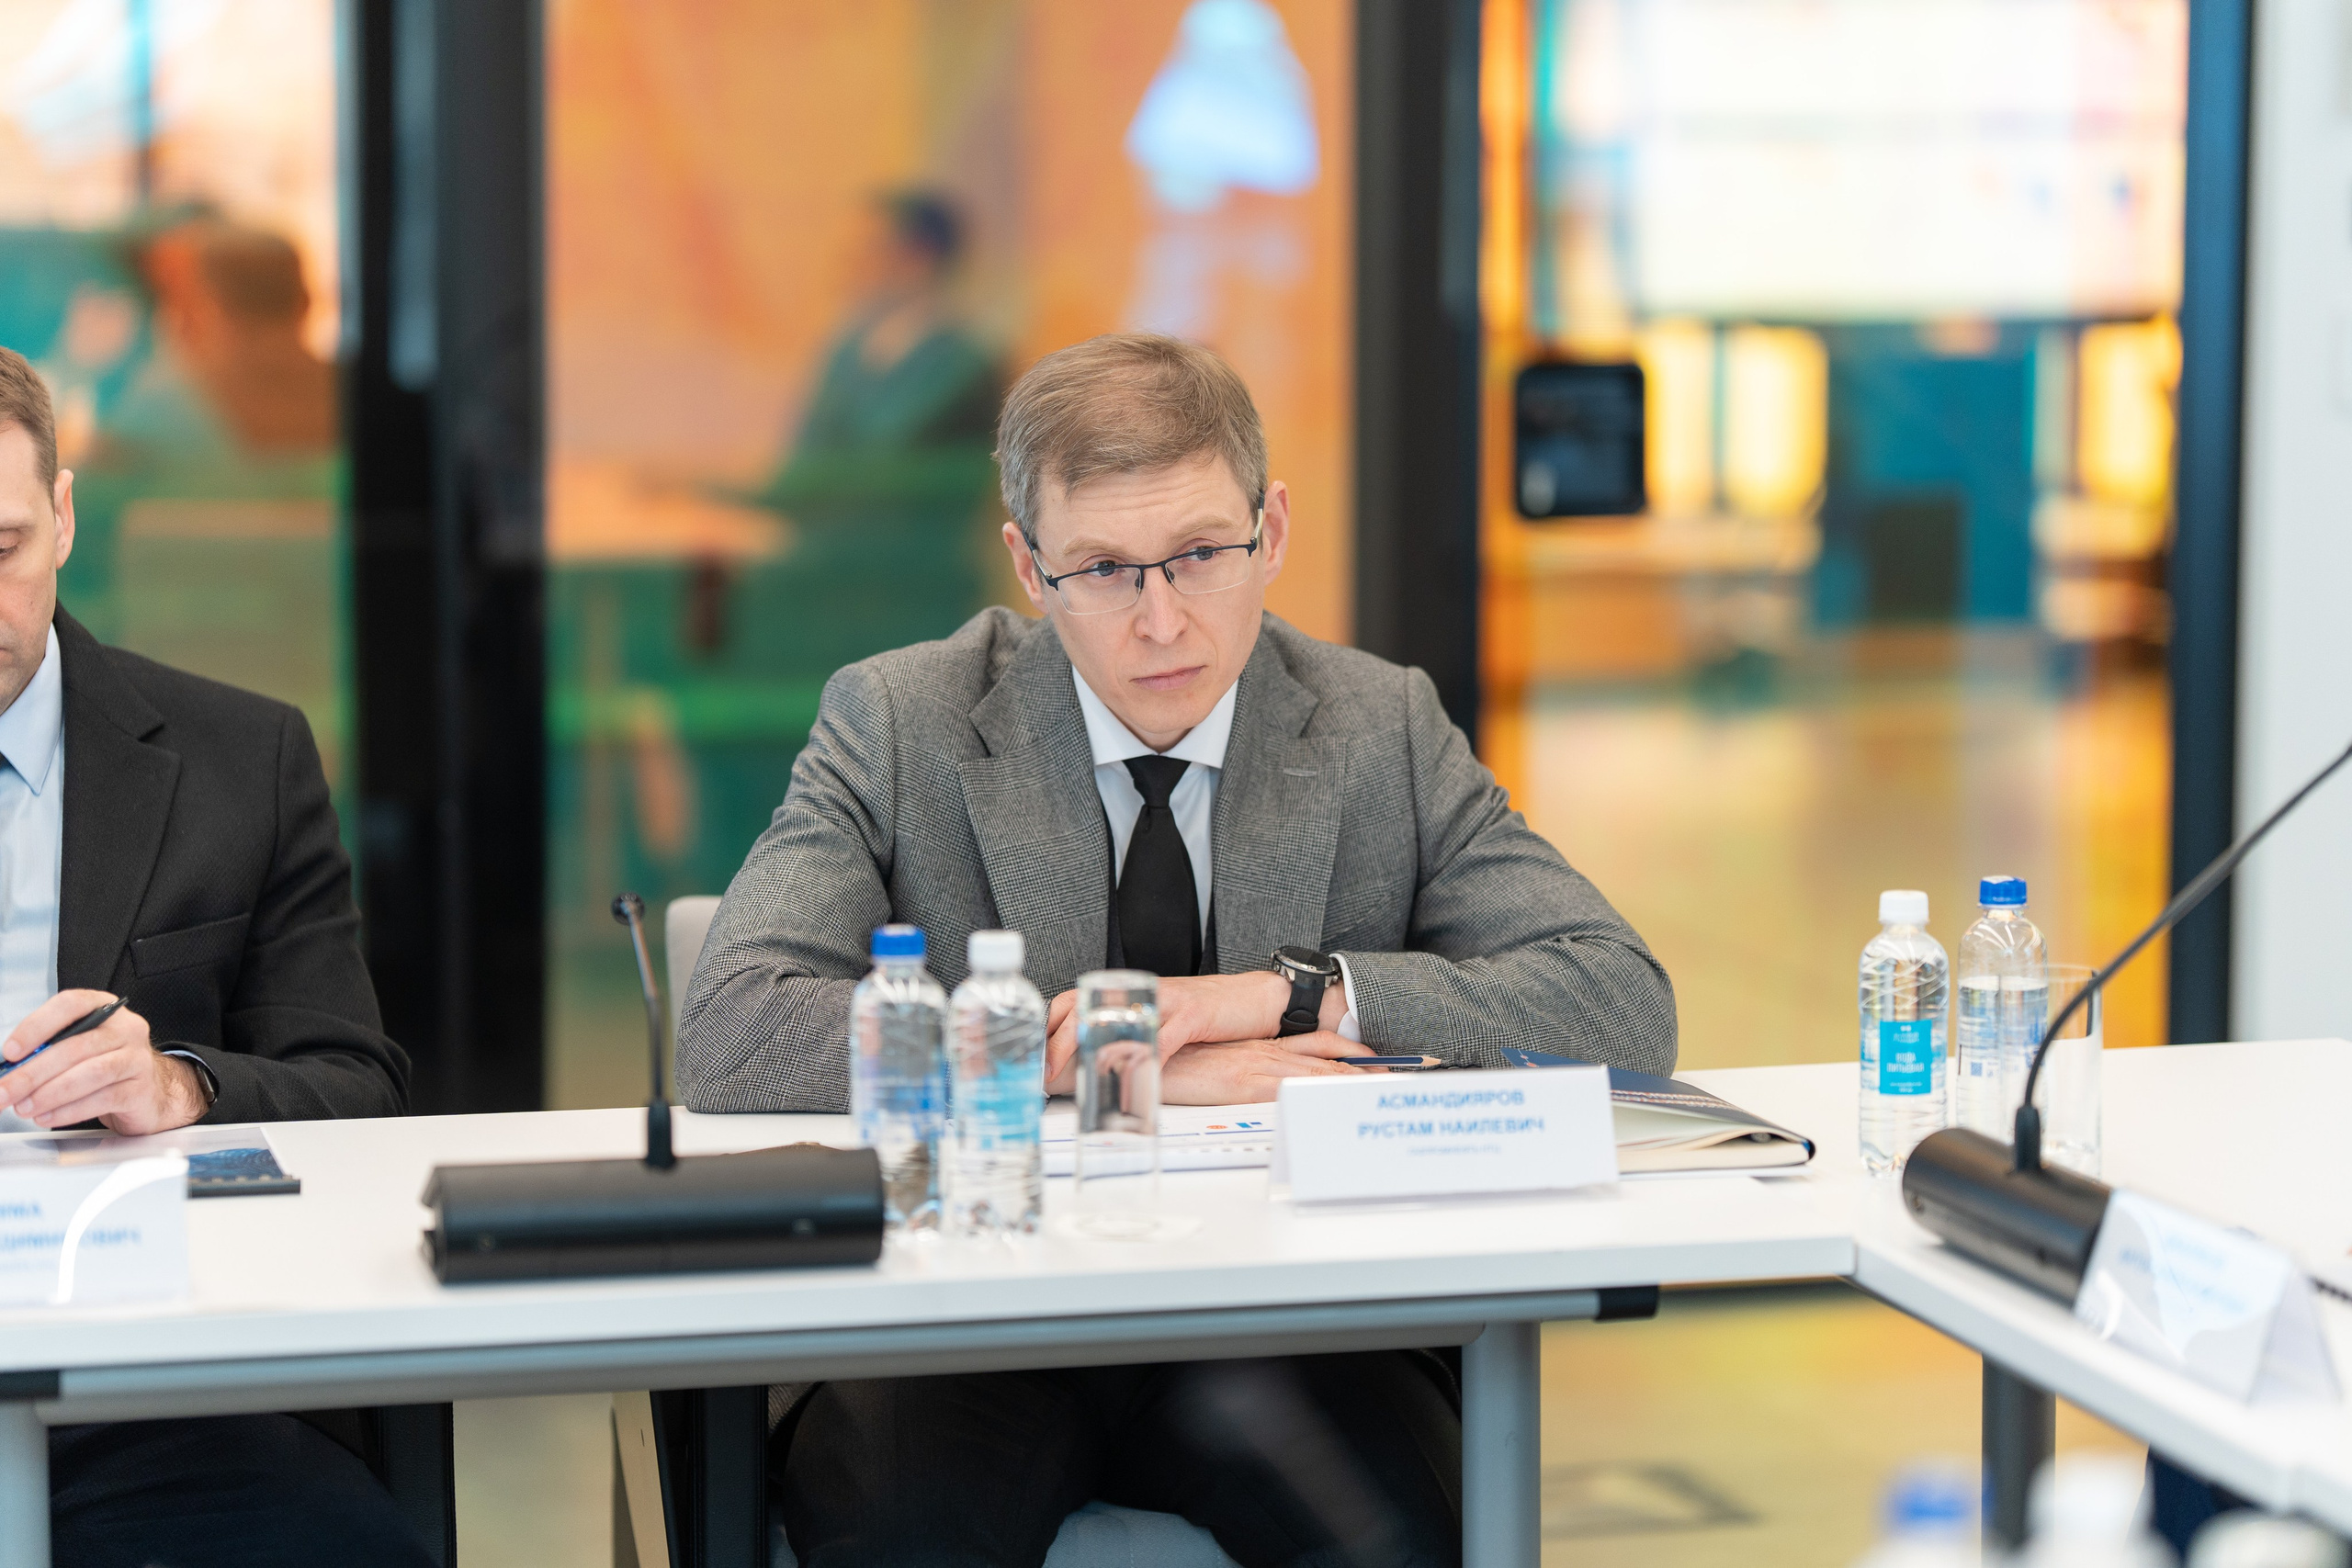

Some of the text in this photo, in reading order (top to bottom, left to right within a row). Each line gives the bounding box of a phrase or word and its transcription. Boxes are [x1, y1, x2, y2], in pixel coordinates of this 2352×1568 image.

[1377, 1087, 1526, 1110] АСМАНДИЯРОВ
[1357, 1115, 1545, 1139] РУСТАМ НАИЛЕВИЧ
